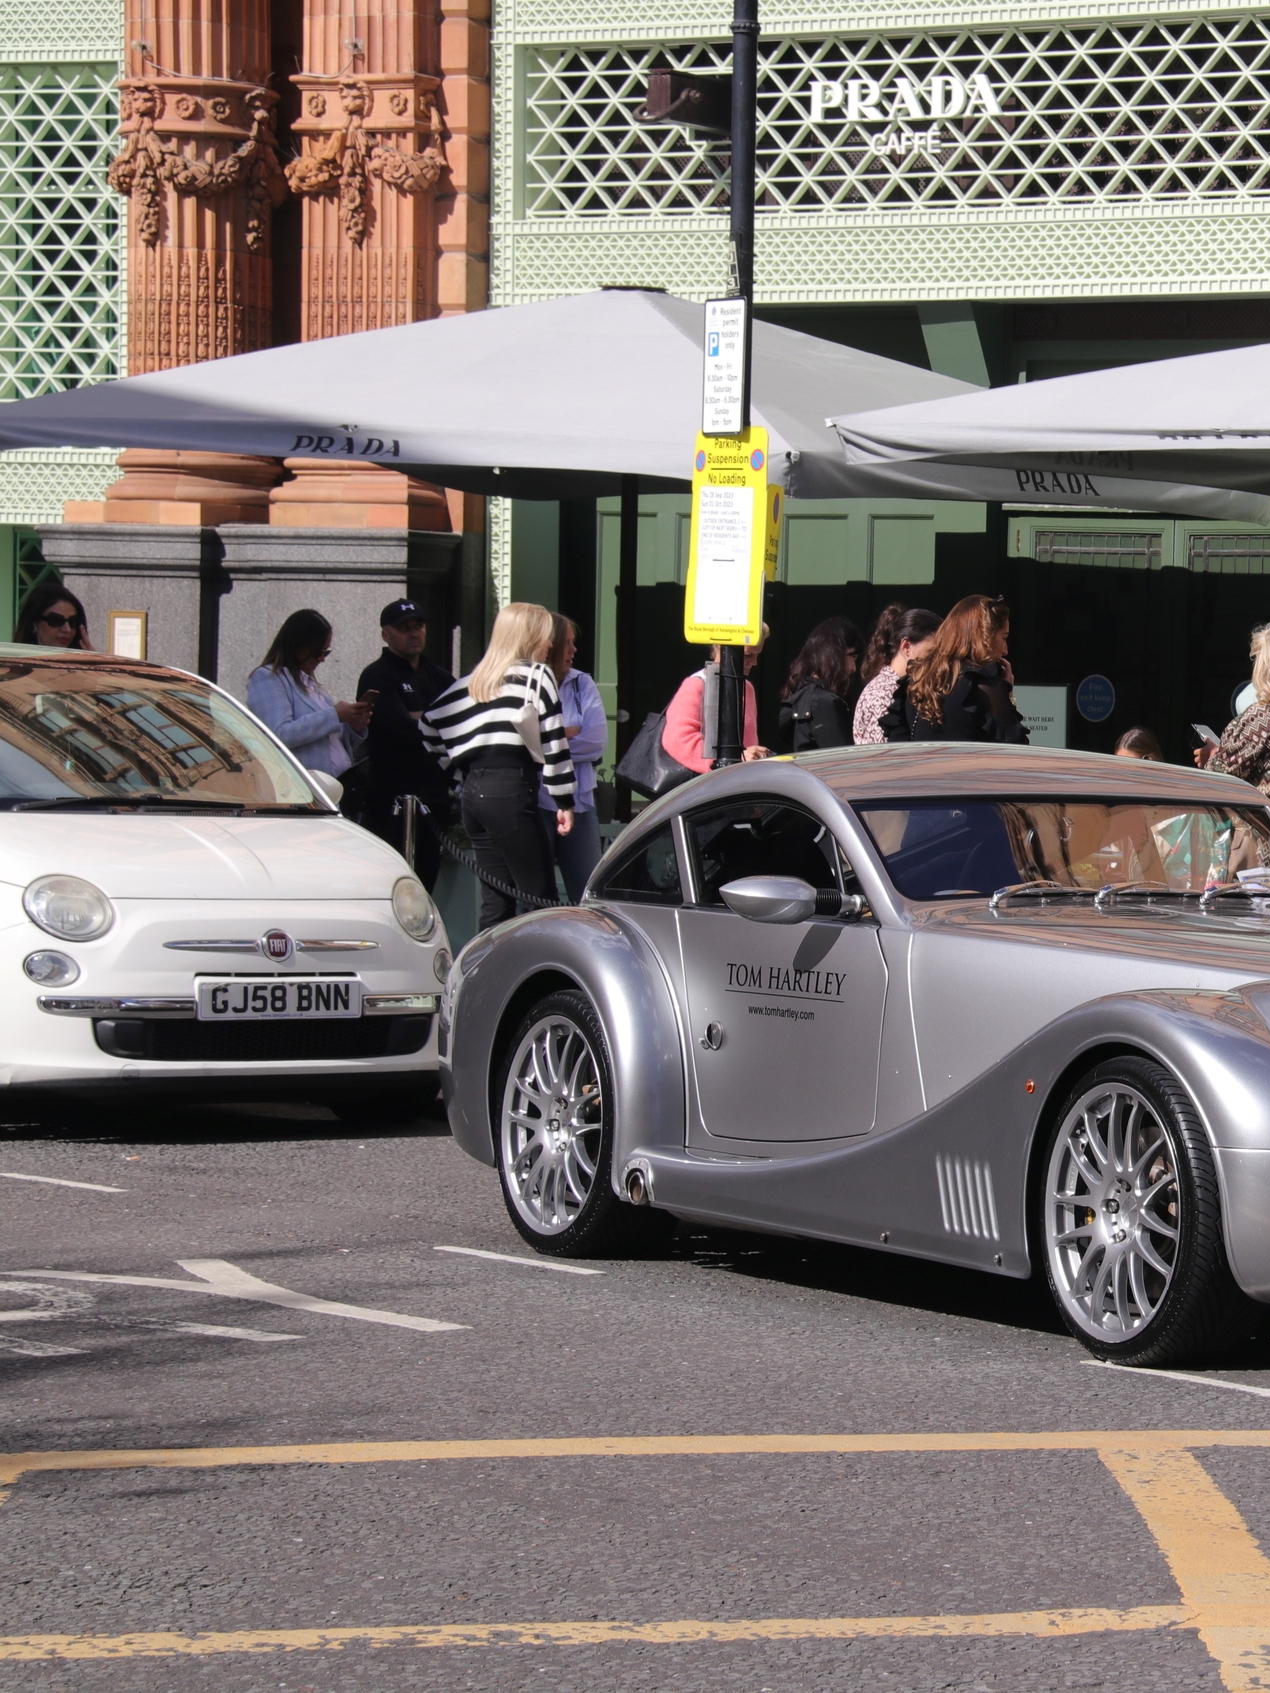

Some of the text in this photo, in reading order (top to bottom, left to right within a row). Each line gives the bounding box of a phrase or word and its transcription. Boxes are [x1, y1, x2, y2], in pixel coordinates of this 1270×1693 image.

[808, 74, 1004, 122] PRADA
[720, 307, 742, 316] Resident
[722, 318, 739, 329] permit
[721, 330, 740, 339] holders
[725, 341, 735, 351] only
[727, 373, 738, 383] 10pm
[713, 385, 732, 395] Saturday
[714, 407, 730, 416] Sunday
[723, 417, 732, 427] 5pm
[290, 435, 400, 457] PRADA
[714, 437, 742, 451] Parking
[707, 453, 749, 465] Suspension
[708, 472, 746, 487] No Loading
[1015, 469, 1101, 496] PRADA
[1089, 683, 1103, 691] Fire
[1094, 694, 1111, 703] keep
[269, 938, 287, 953] FIAT
[726, 963, 847, 996] TOM HARTLEY
[211, 983, 350, 1014] GJ58 BNN
[748, 1005, 815, 1021] www.tomhartley.com
